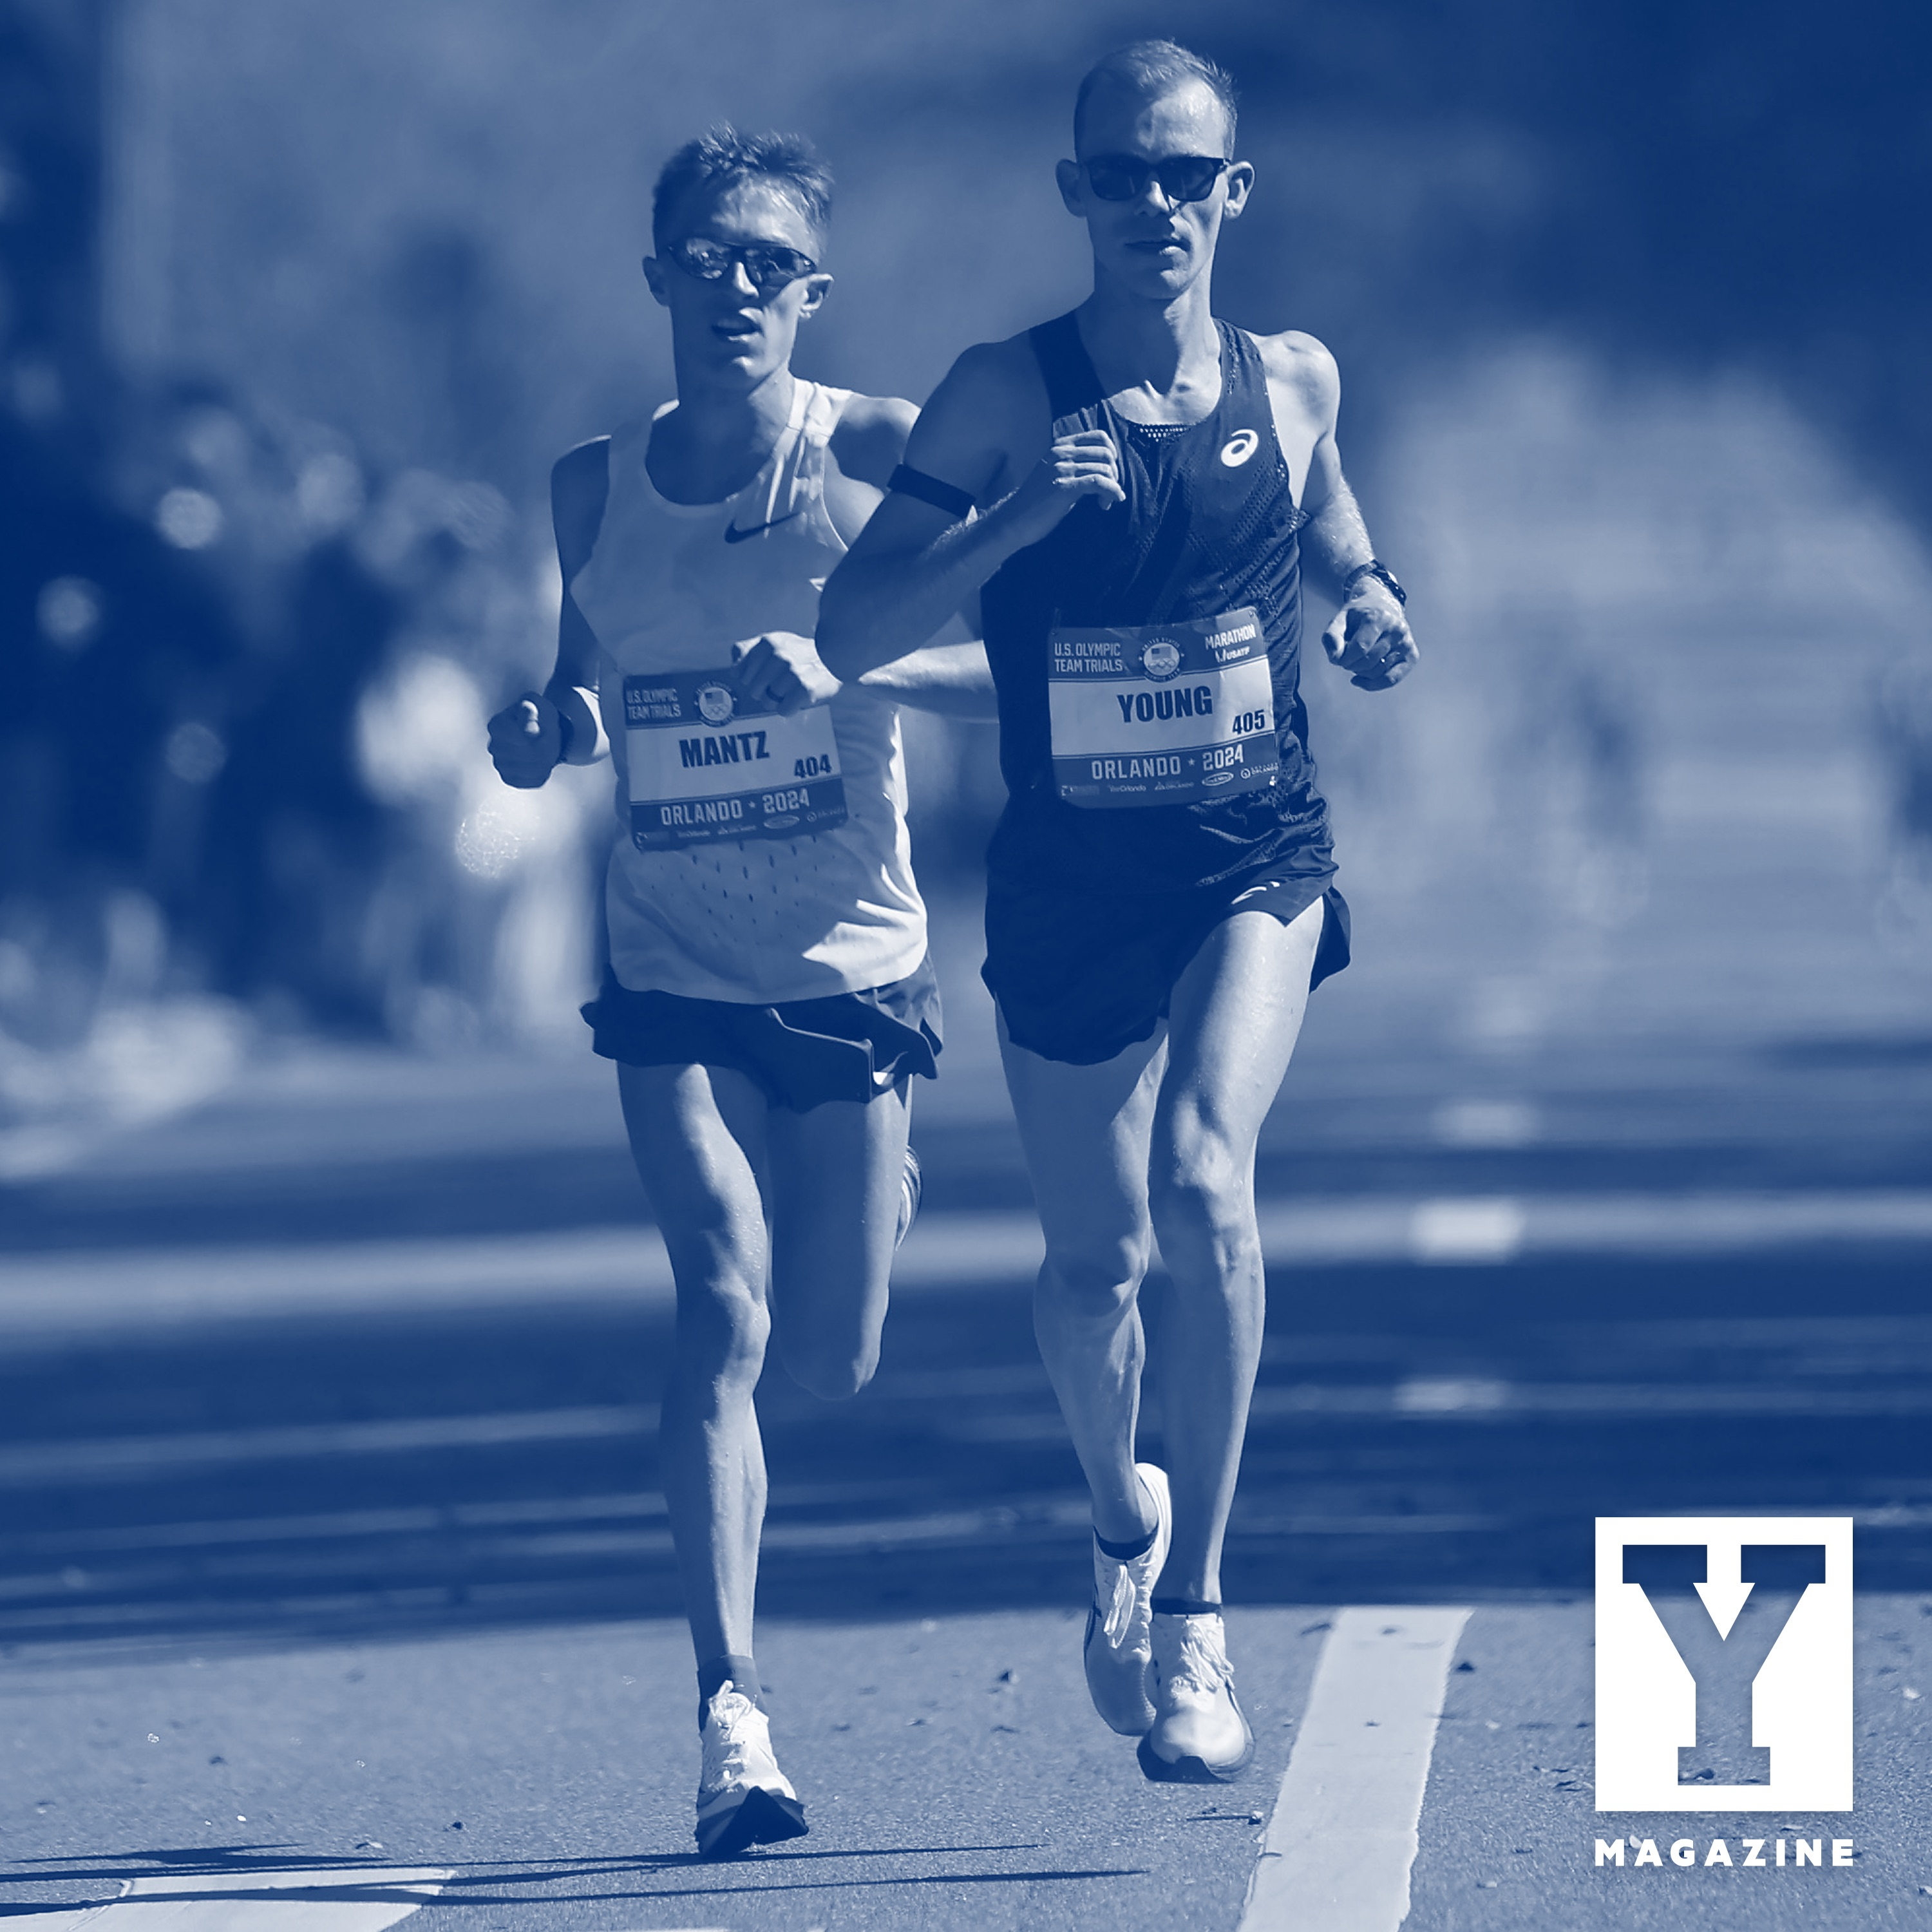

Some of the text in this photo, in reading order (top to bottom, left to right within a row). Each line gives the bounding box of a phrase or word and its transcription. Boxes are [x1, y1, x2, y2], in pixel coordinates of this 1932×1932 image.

[1054, 642, 1121, 656] U.S. OLYMPIC
[1205, 623, 1256, 650] MARATHON
[1054, 659, 1123, 673] TEAM TRIALS
[1116, 685, 1213, 723] YOUNG
[1232, 709, 1265, 735] 405
[679, 730, 770, 768] MANTZ
[1091, 744, 1244, 781] ORLANDO 2024
[794, 753, 832, 779] 404
[660, 799, 743, 826] ORLANDO
[762, 788, 810, 813] 2024
